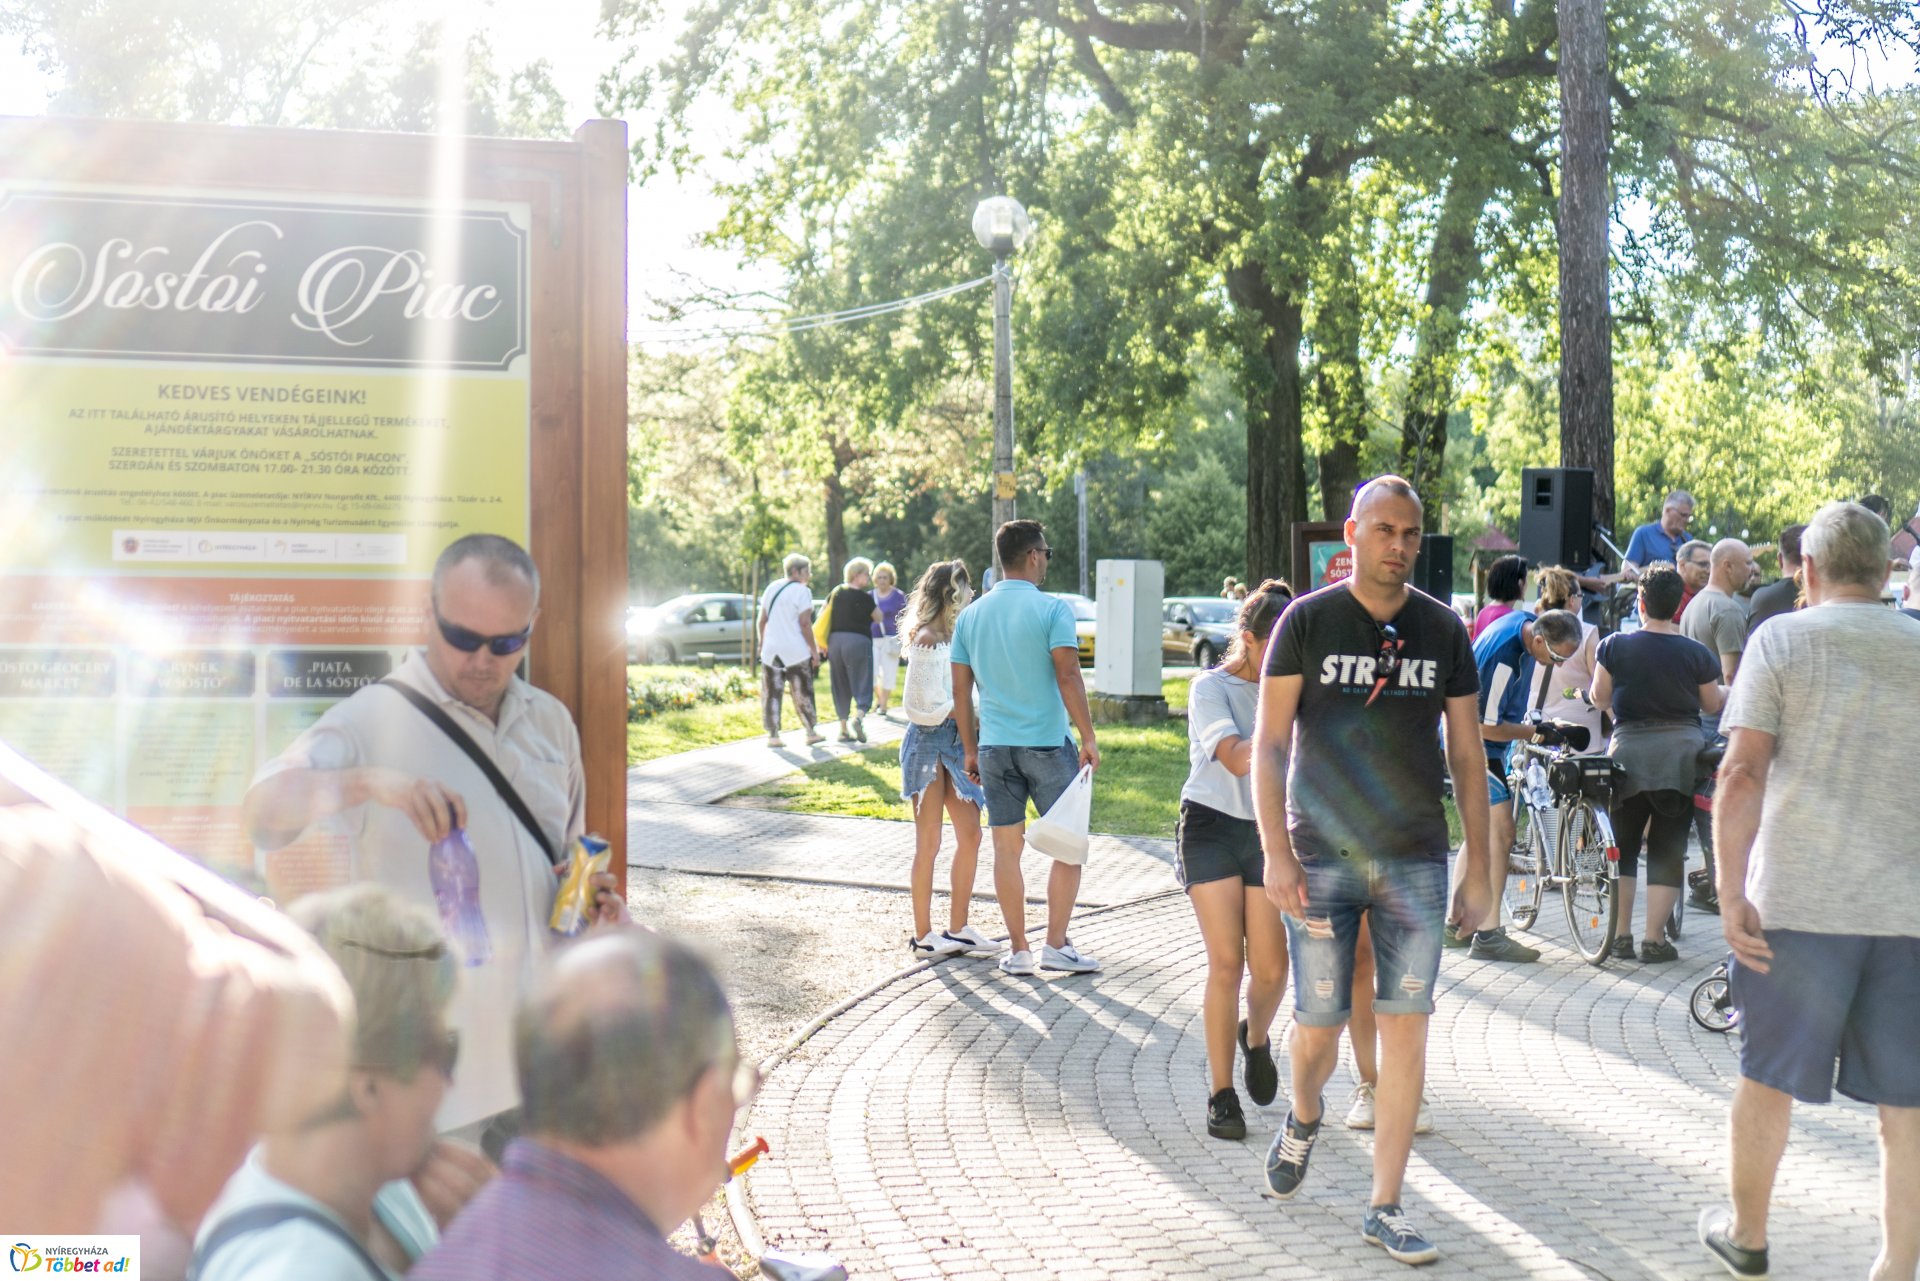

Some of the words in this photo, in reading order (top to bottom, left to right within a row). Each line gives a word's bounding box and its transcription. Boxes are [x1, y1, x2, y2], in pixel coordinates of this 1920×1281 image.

[11, 220, 284, 322] Sóstói
[291, 245, 503, 347] Piac
[158, 384, 231, 401] KEDVES
[236, 384, 367, 405] VENDÉGEINK!
[68, 408, 85, 419] AZ
[88, 408, 107, 419] ITT
[110, 408, 180, 421] TALÁLHATÓ
[183, 409, 235, 423] ÁRUSÍTÓ
[239, 412, 299, 425] HELYEKEN
[111, 447, 189, 459] SZERETETTEL
[192, 447, 237, 461] VÁRJUK
[240, 448, 288, 462] ÖNÖKET
[293, 451, 301, 461] A
[108, 459, 165, 471] SZERDÁN
[168, 459, 182, 472] ÉS
[185, 462, 260, 474] SZOMBATON
[335, 463, 361, 476] ÓRA
[283, 675, 301, 688] DE
[305, 675, 324, 688] LA
